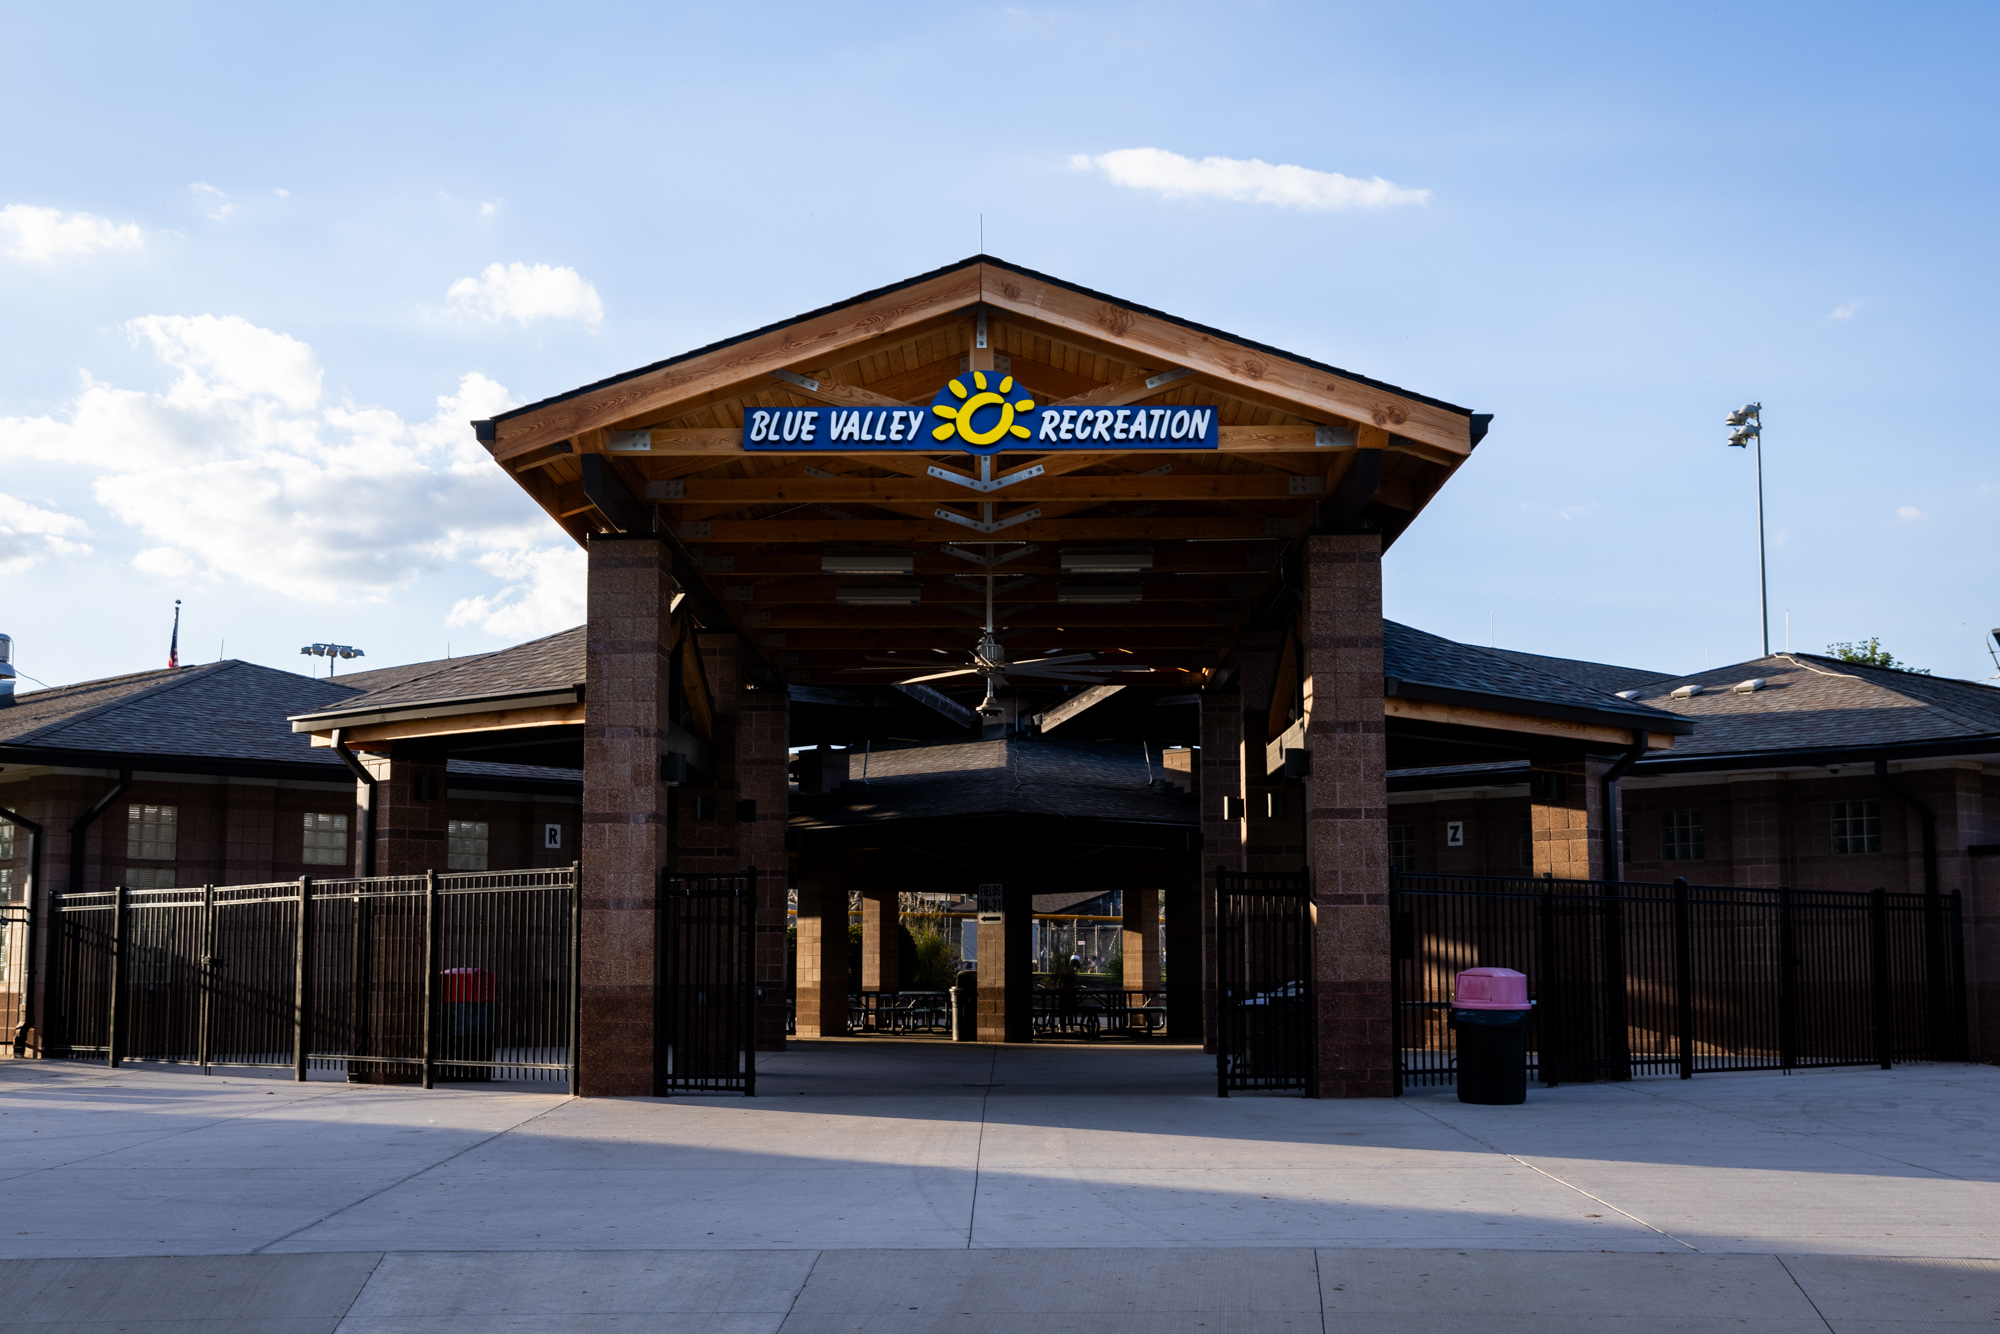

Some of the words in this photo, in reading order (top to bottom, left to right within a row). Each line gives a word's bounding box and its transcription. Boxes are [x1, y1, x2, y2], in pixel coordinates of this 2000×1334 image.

[749, 410, 819, 441] BLUE
[830, 410, 924, 441] VALLEY
[1039, 409, 1211, 442] RECREATION
[548, 827, 558, 845] R
[1449, 825, 1460, 842] Z
[980, 885, 1001, 897] FIELDS
[980, 898, 1001, 913] 18-21
